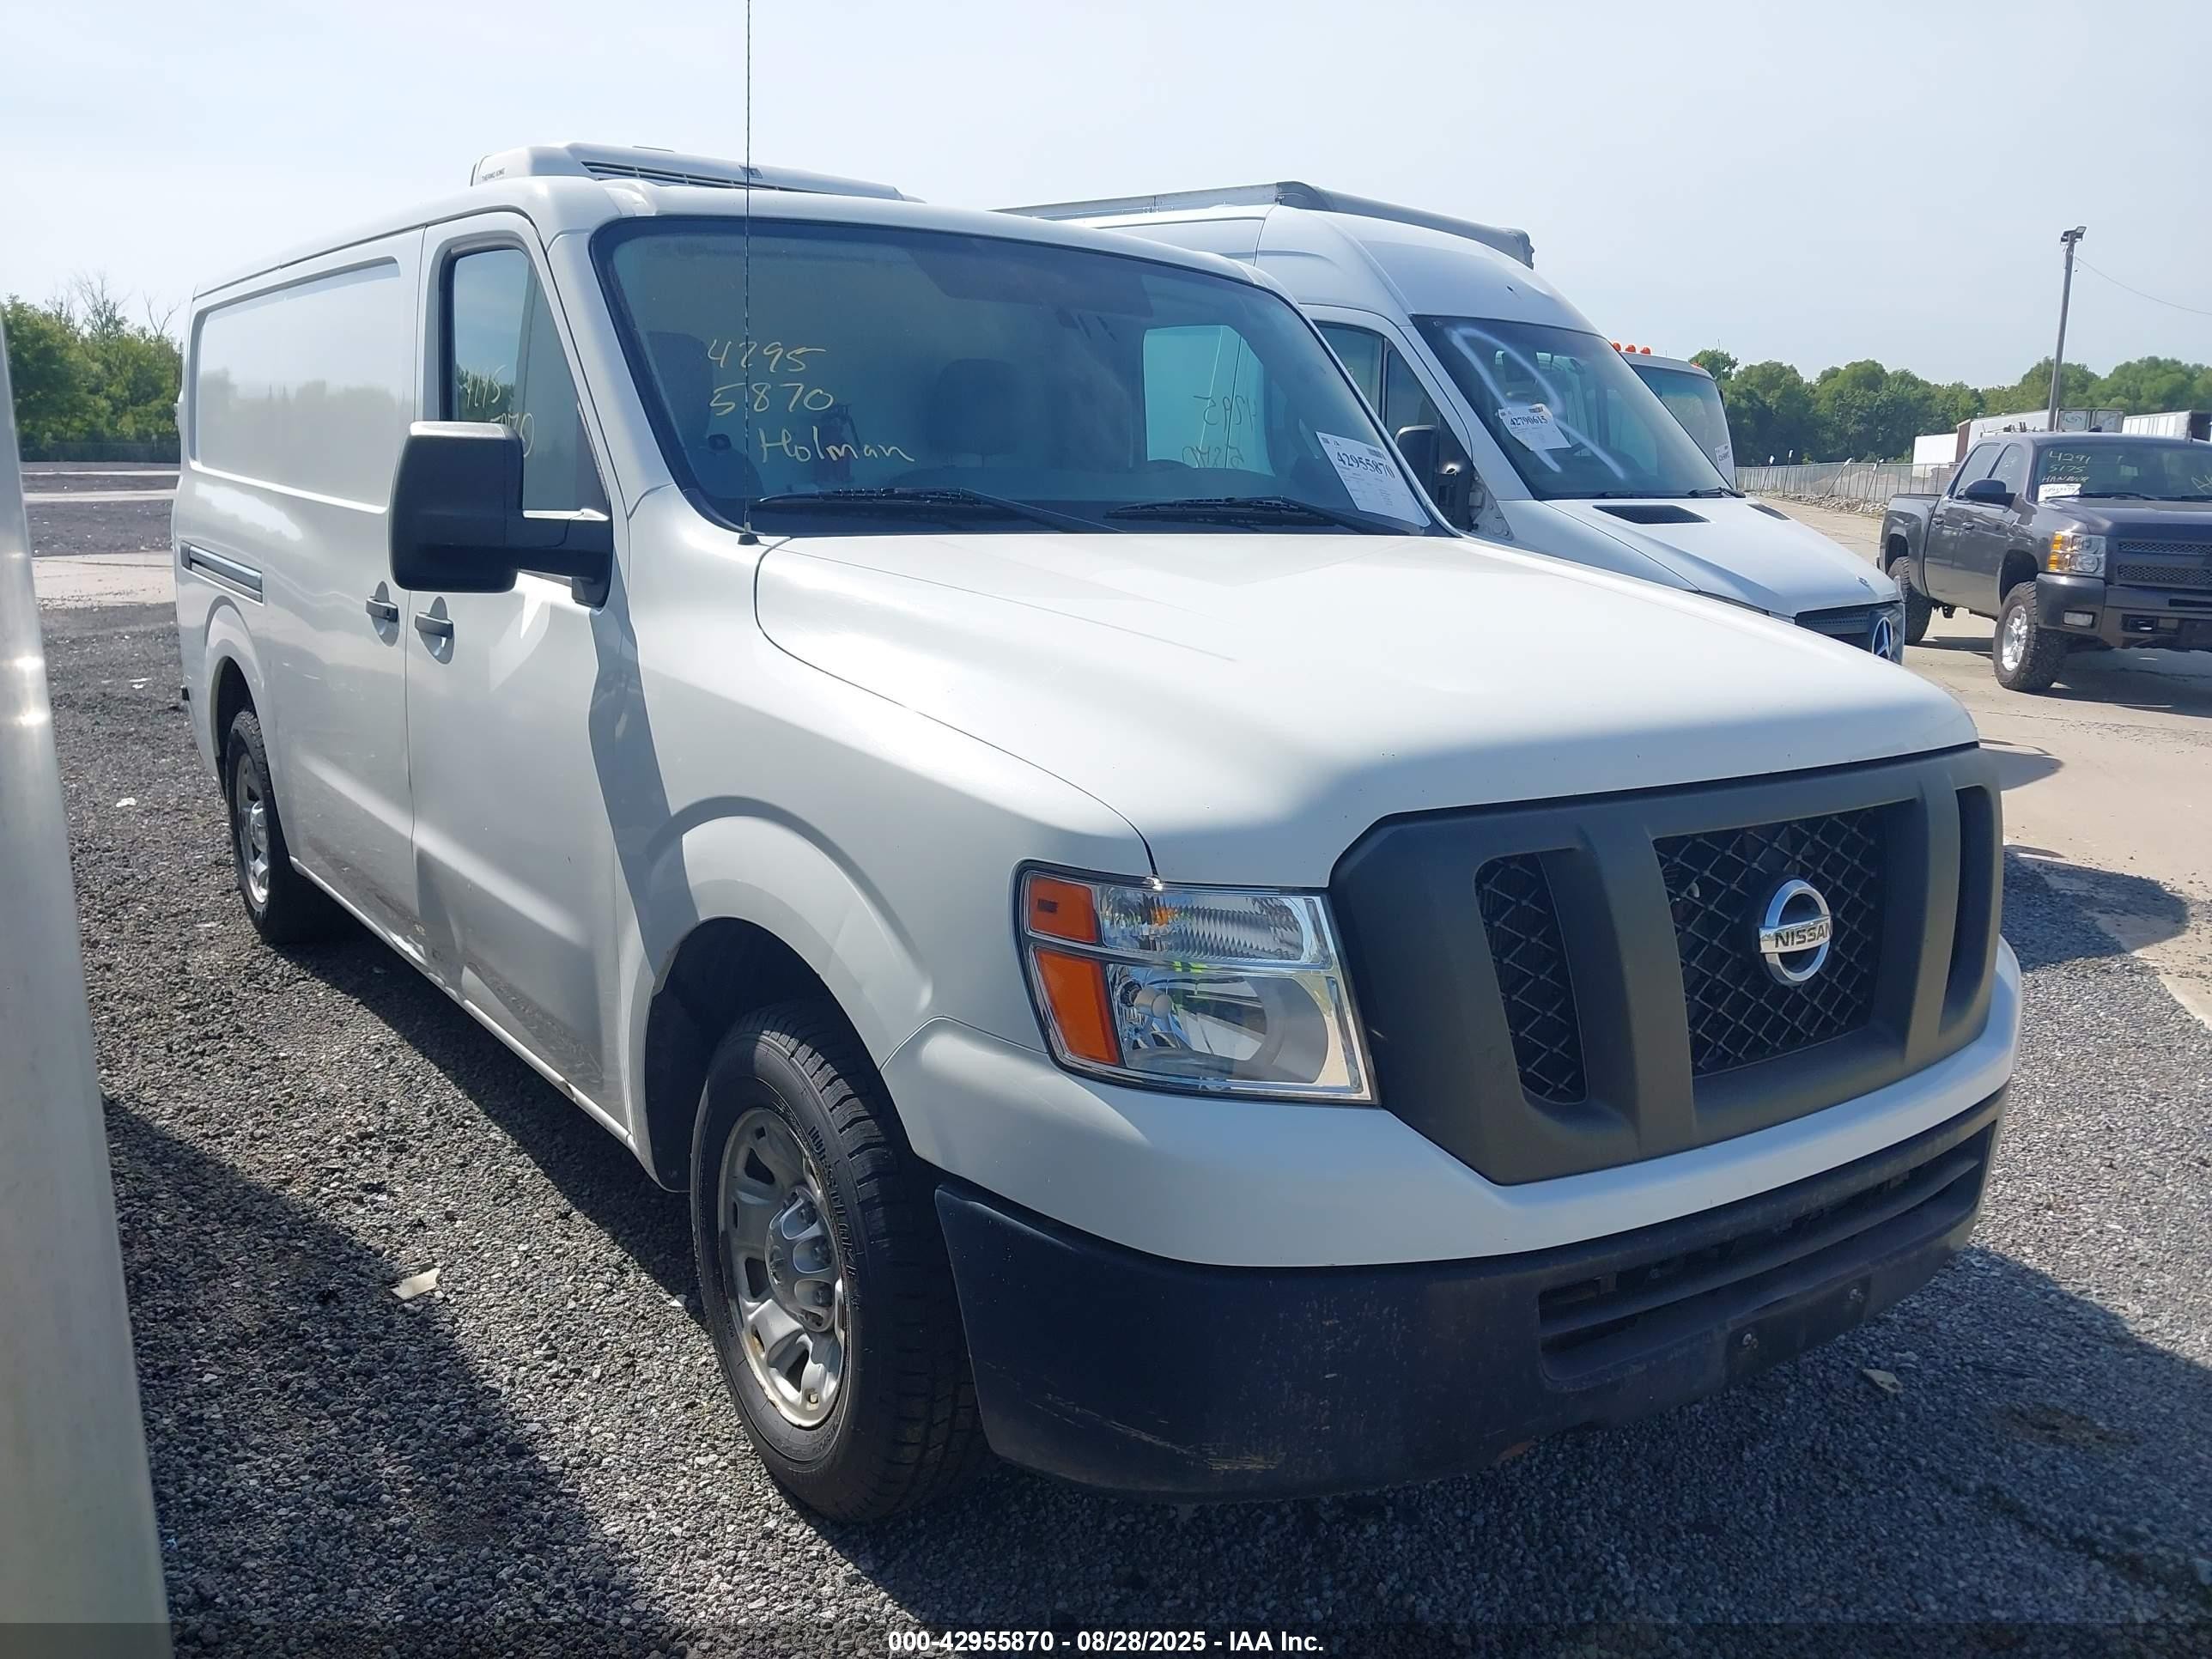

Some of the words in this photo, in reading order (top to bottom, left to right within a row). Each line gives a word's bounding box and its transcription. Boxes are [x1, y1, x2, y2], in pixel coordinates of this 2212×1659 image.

[707, 338, 826, 372] 4295
[709, 382, 834, 416] 5870
[1510, 416, 1548, 426] 42790615
[758, 425, 915, 463] Holman
[2049, 450, 2092, 465] 4291
[1336, 451, 1395, 479] 42955870
[2048, 464, 2087, 473] 5175
[1774, 921, 1832, 949] NISSAN
